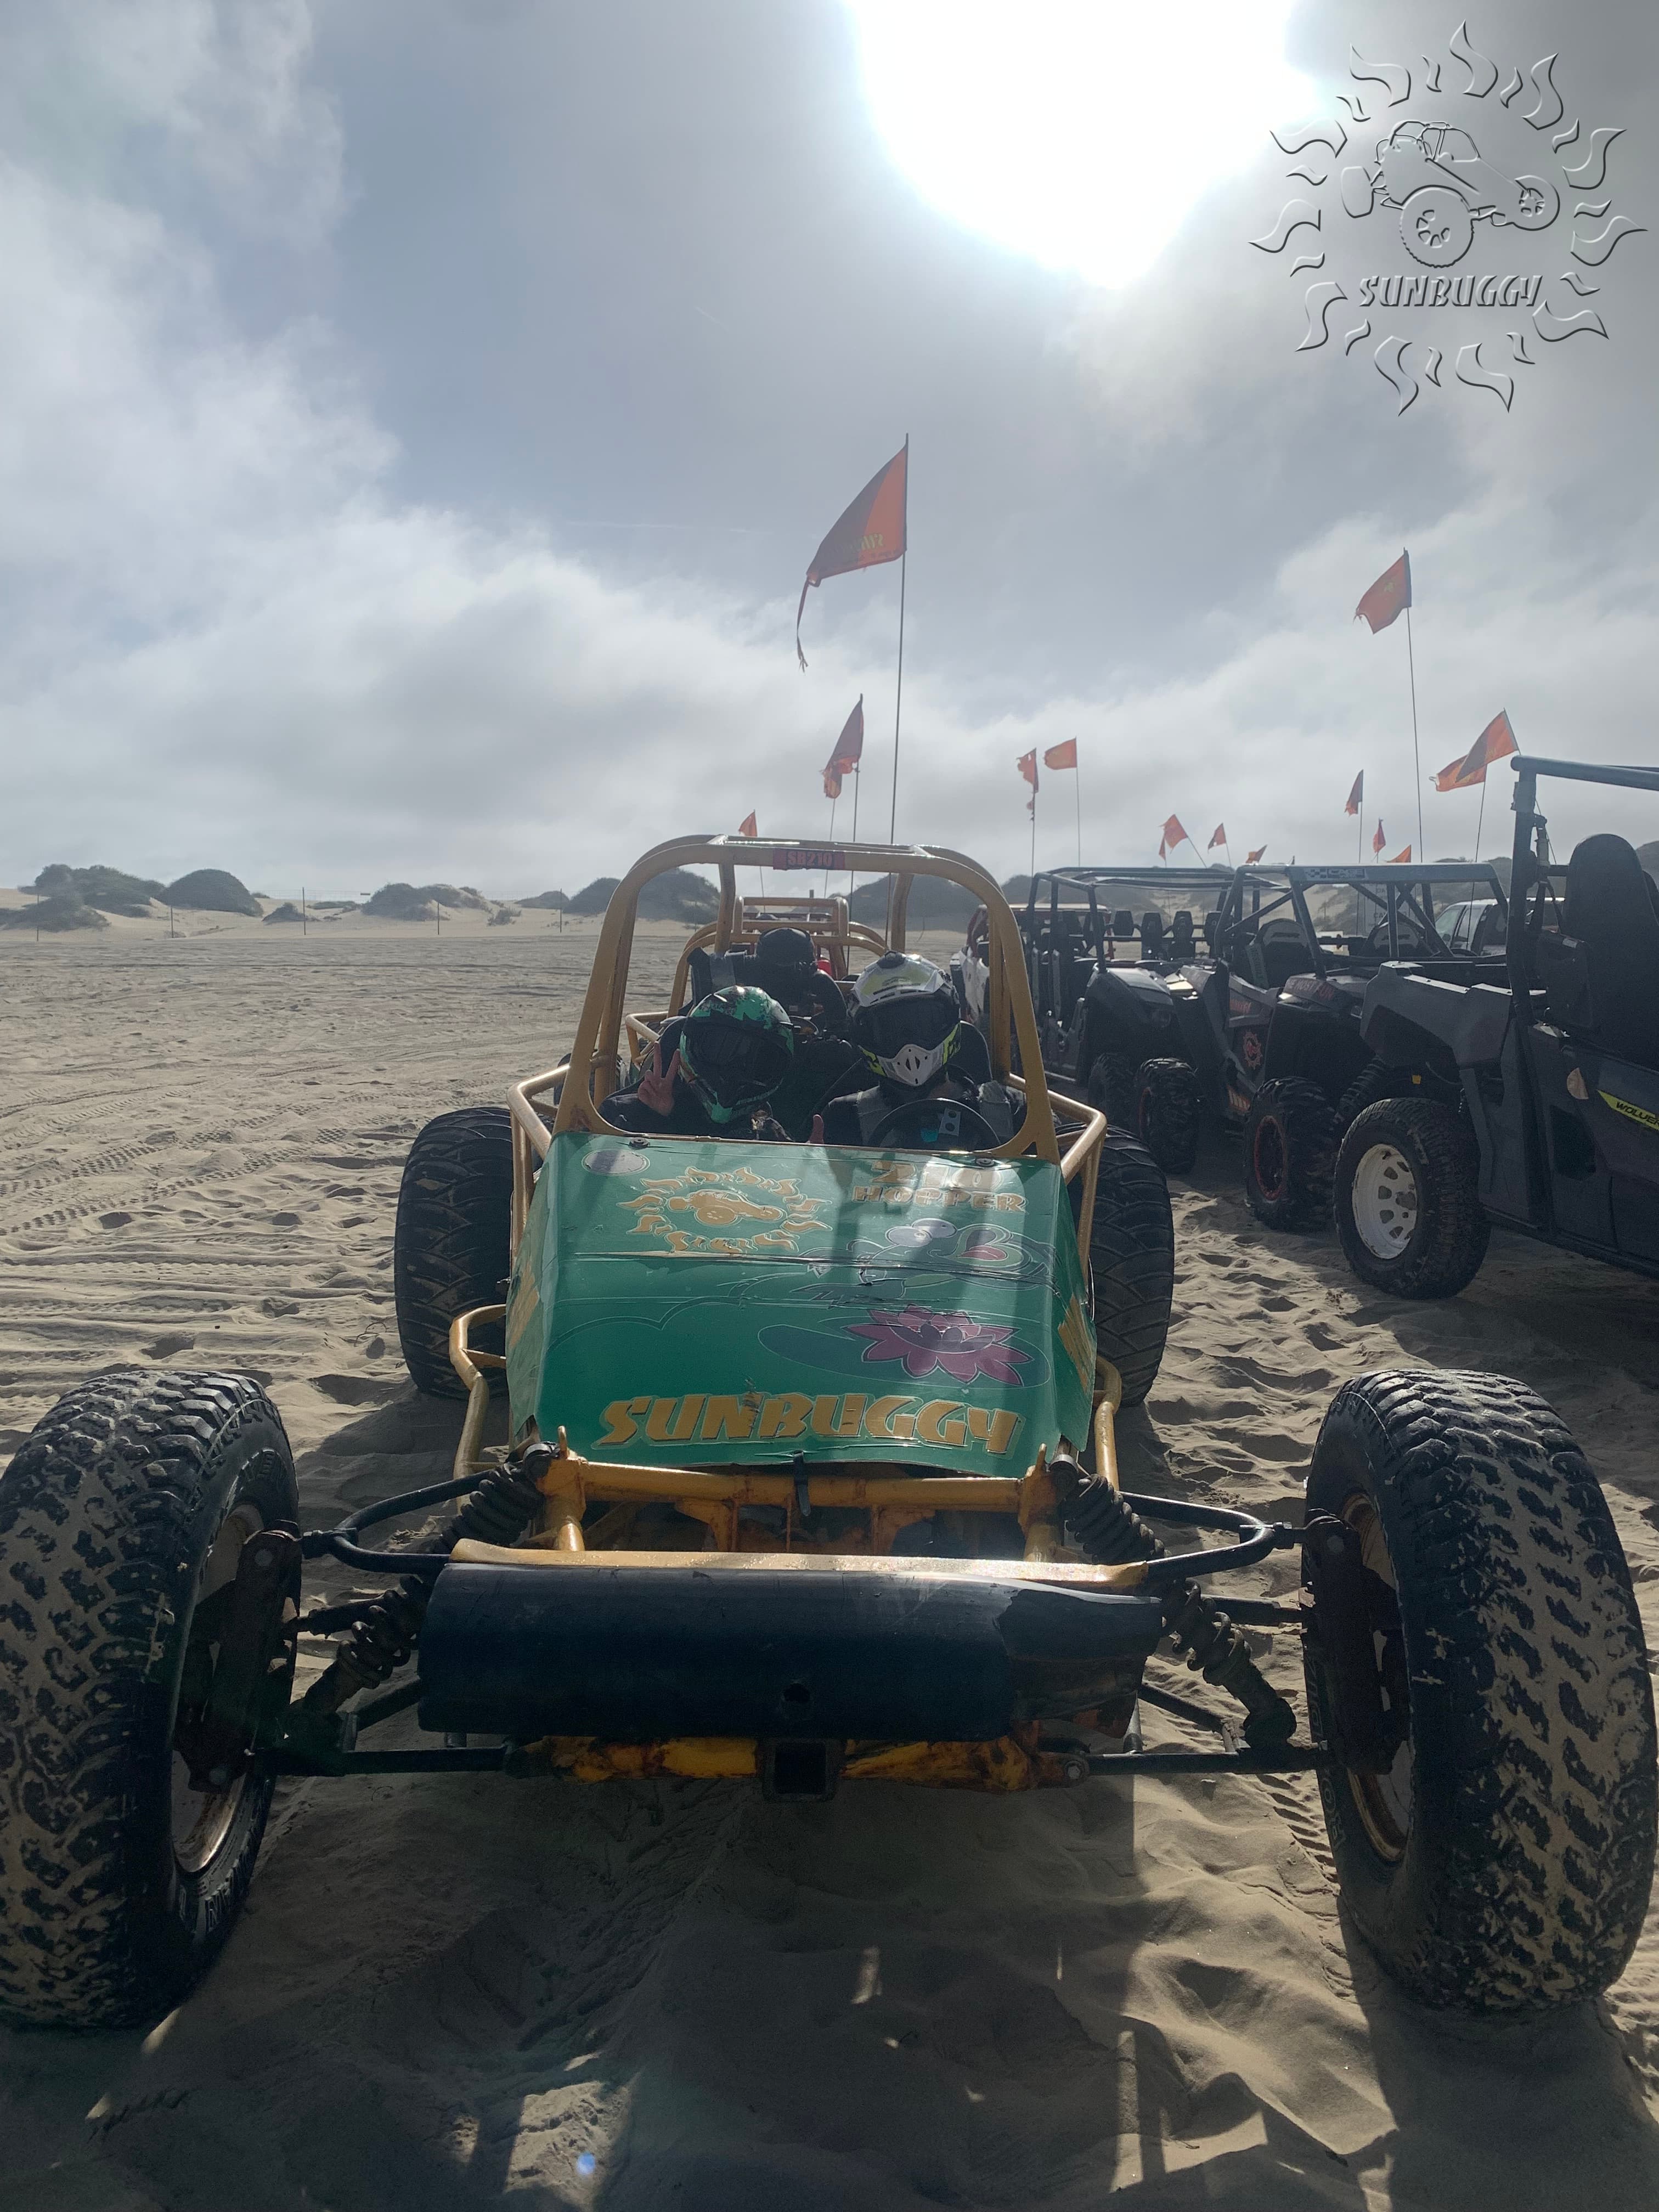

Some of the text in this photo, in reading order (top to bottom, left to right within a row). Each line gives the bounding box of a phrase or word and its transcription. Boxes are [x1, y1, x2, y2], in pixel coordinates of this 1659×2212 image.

[870, 1160, 1004, 1190] 210
[851, 1185, 1028, 1213] HOPPER
[597, 1392, 1020, 1454] SUNBUGGY
